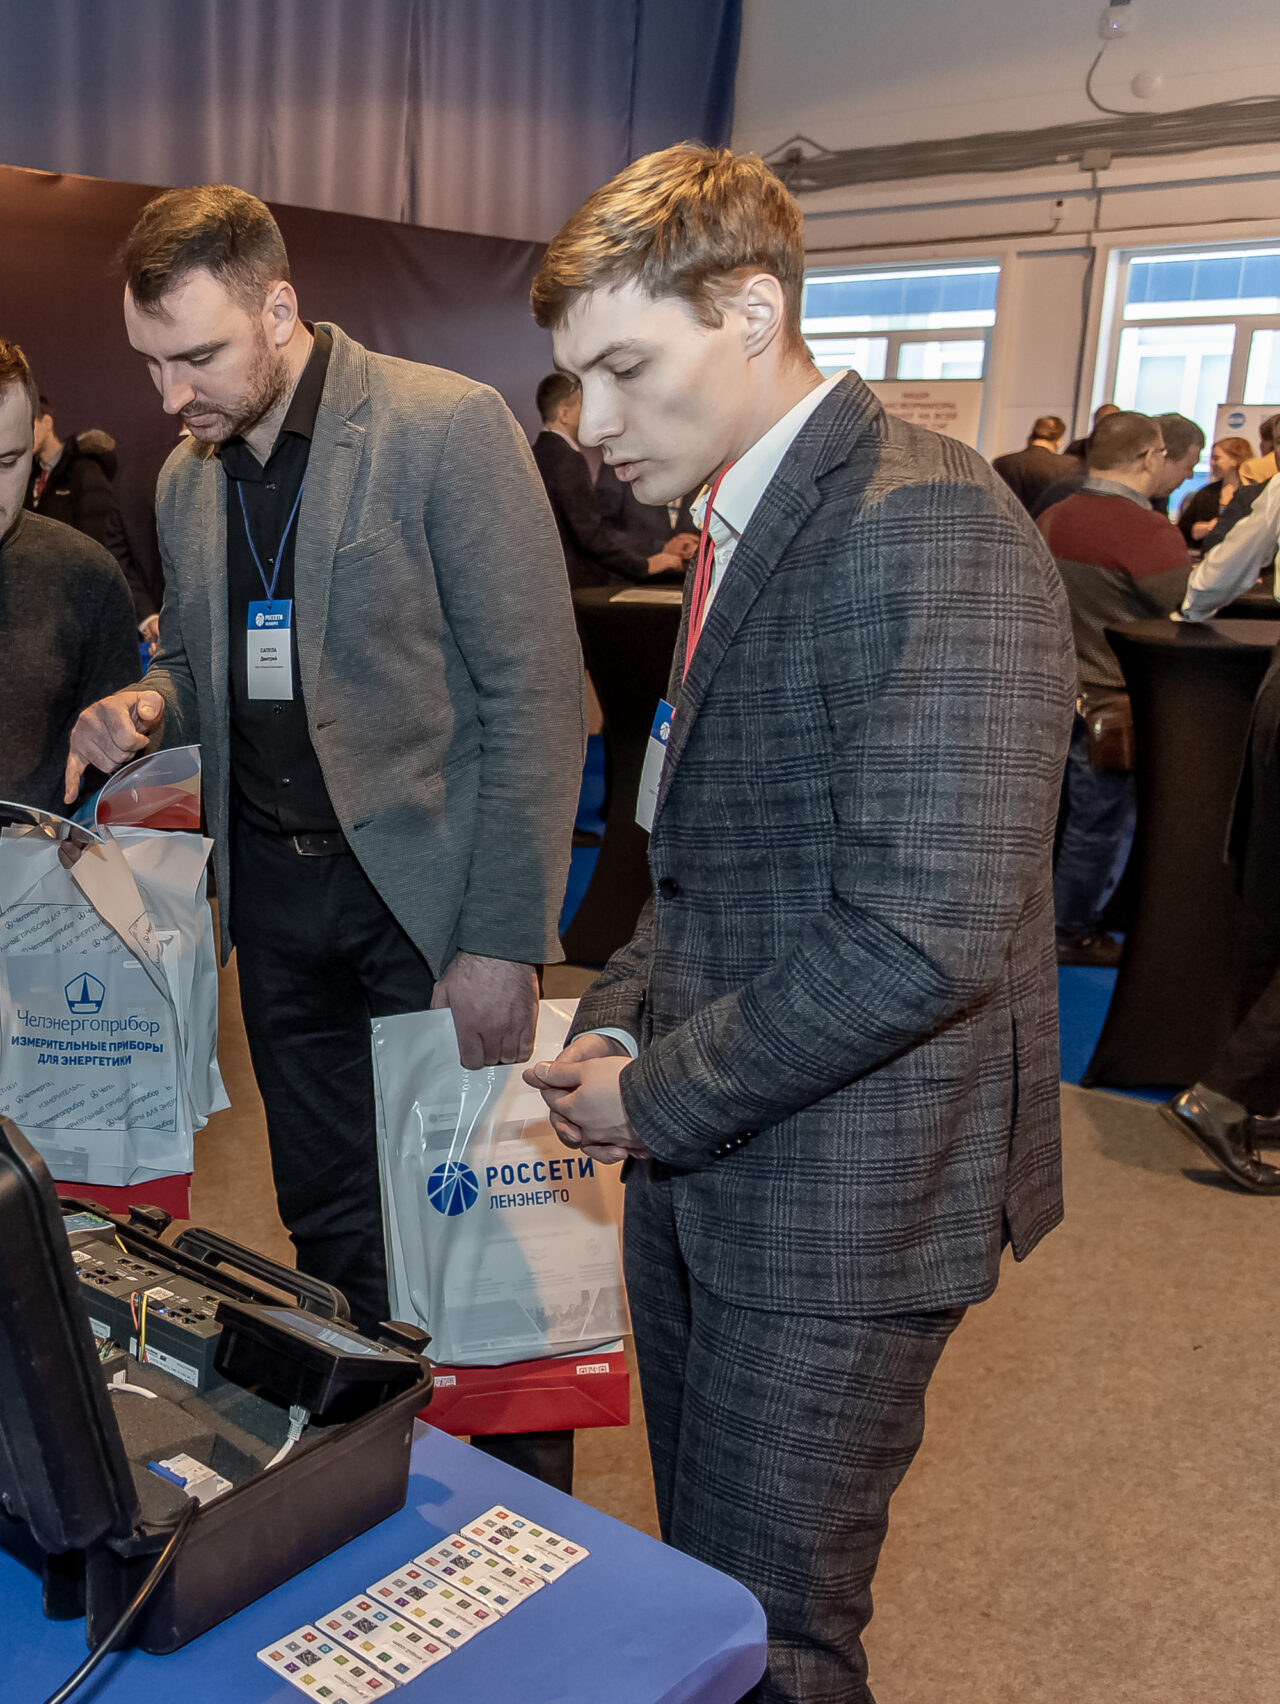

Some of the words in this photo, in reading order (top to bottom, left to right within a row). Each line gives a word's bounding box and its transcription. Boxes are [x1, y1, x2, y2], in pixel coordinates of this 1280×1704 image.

[17, 1009, 160, 1037] Челэнергоприбор
[11, 1036, 107, 1052] ИЗМЕРИТЕЛЬНЫЕ
[109, 1041, 163, 1053] ПРИБОРЫ
[38, 1053, 59, 1065] ДЛЯ
[61, 1055, 132, 1067] ЭНЕРГЕТИКИ
[486, 1157, 595, 1188] РОССЕТИ
[490, 1189, 570, 1210] ЛЕНЭНЕРГО
